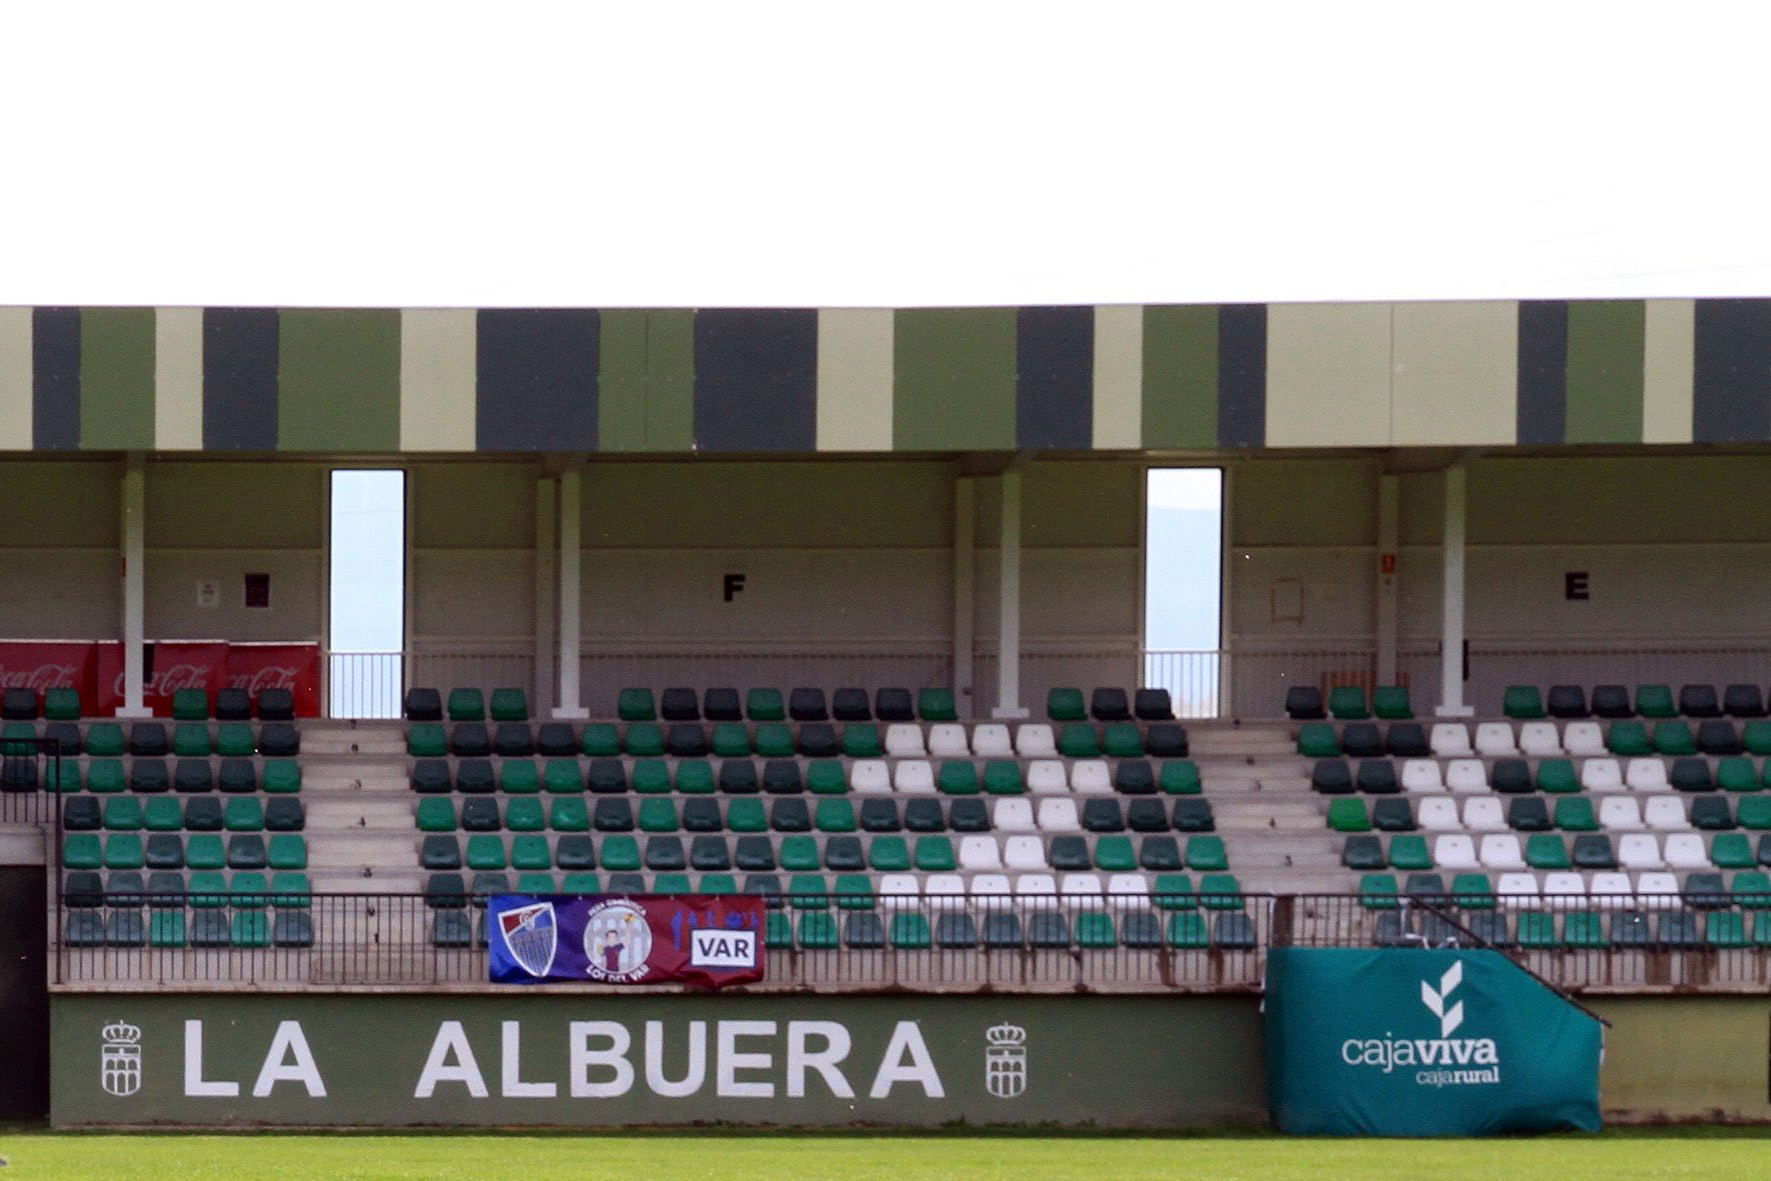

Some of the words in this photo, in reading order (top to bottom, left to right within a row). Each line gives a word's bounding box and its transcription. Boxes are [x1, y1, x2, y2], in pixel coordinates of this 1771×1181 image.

[723, 573, 746, 603] F
[1564, 571, 1590, 601] E
[697, 937, 750, 959] VAR
[185, 1019, 327, 1098] LA
[414, 1020, 945, 1099] ALBUERA
